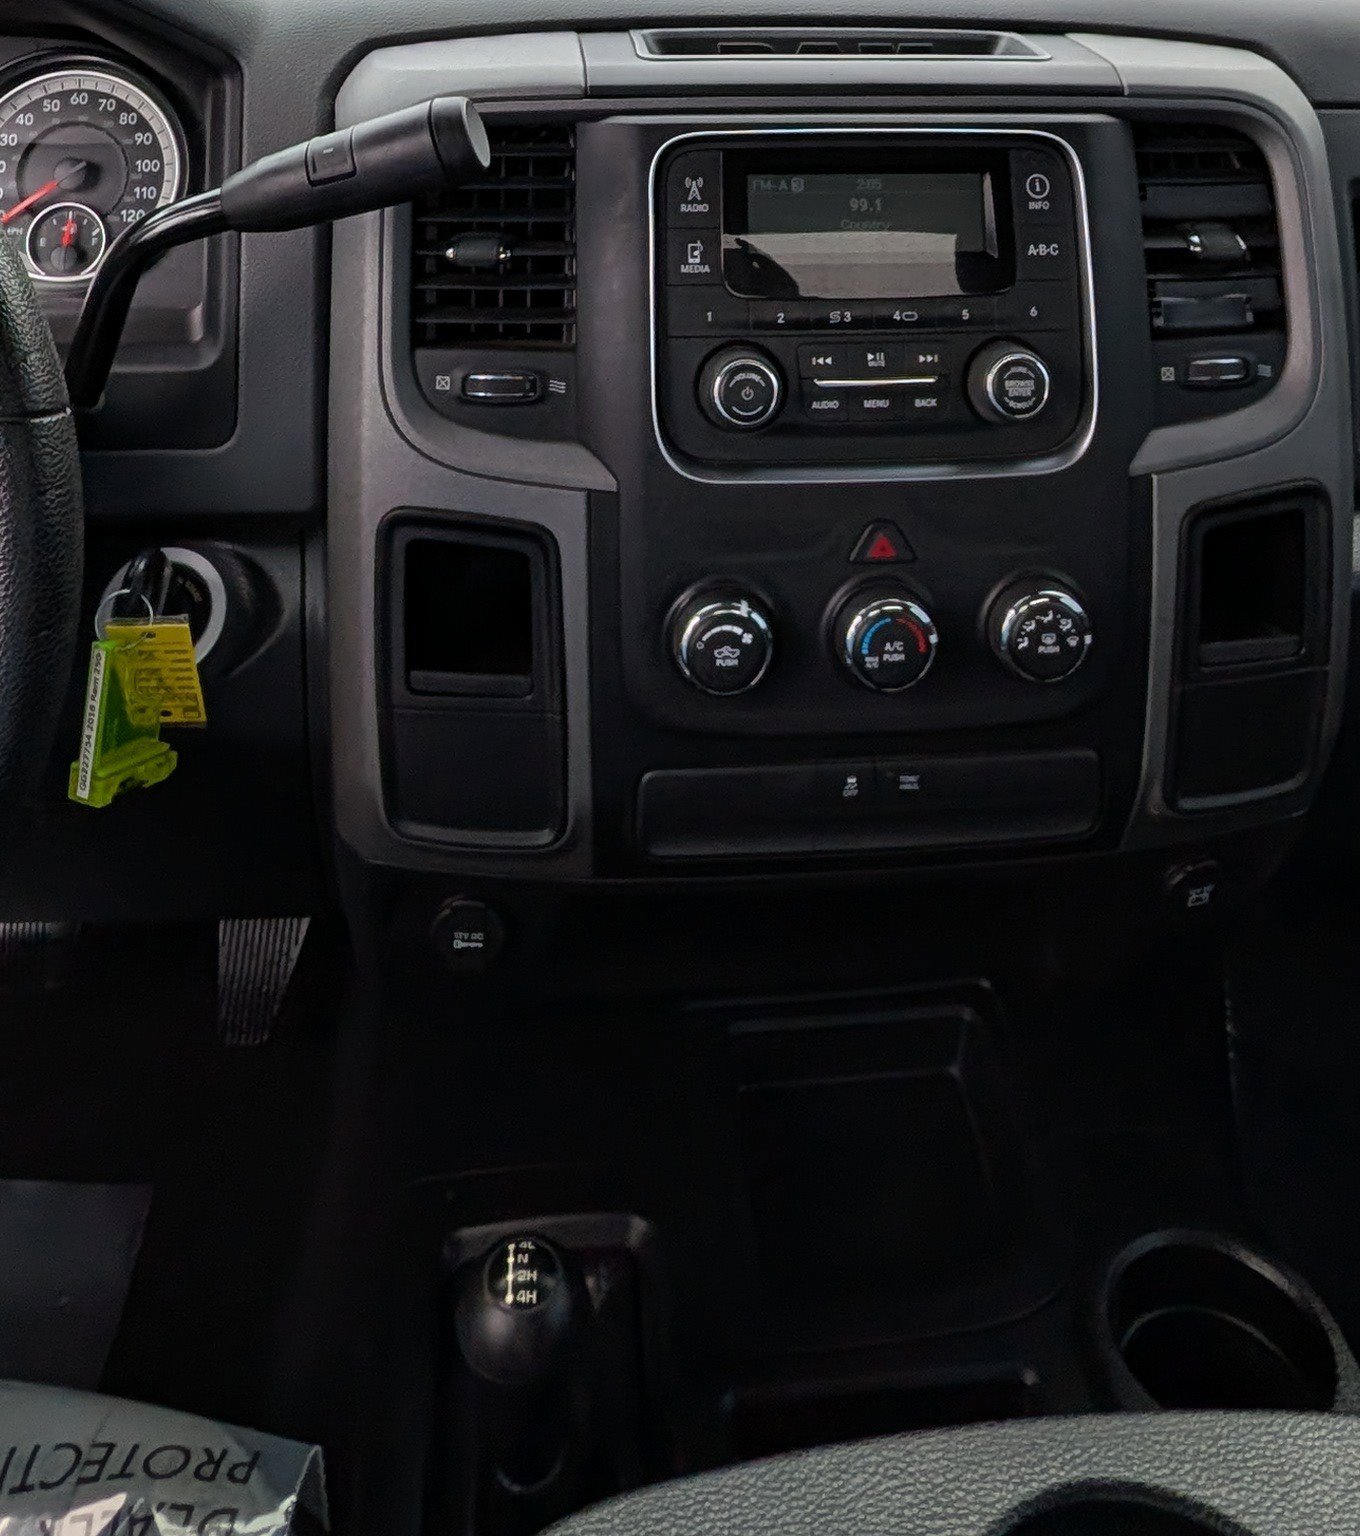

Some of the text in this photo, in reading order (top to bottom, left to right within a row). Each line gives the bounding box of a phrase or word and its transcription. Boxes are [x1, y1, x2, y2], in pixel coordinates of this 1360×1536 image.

[70, 93, 88, 105] 60
[42, 99, 61, 112] 50
[98, 99, 116, 112] 70
[15, 113, 34, 126] 40
[119, 113, 137, 125] 80
[0, 134, 17, 146] 30
[135, 133, 153, 146] 90
[136, 160, 160, 173] 100
[134, 187, 157, 199] 110
[680, 204, 709, 212] RADIO
[1028, 201, 1050, 210] INFO
[121, 209, 145, 223] 120
[680, 265, 711, 274] MEDIA
[706, 311, 713, 322] 1
[843, 311, 851, 322] 3
[893, 310, 901, 321] 4
[961, 309, 969, 320] 5
[1029, 306, 1037, 317] 6
[777, 313, 785, 324] 2
[811, 400, 840, 410] AUDIO
[863, 399, 890, 409] MENU
[914, 398, 937, 408] BACK
[517, 1253, 529, 1264] N
[517, 1270, 537, 1282] 2H
[516, 1290, 537, 1304] 4H
